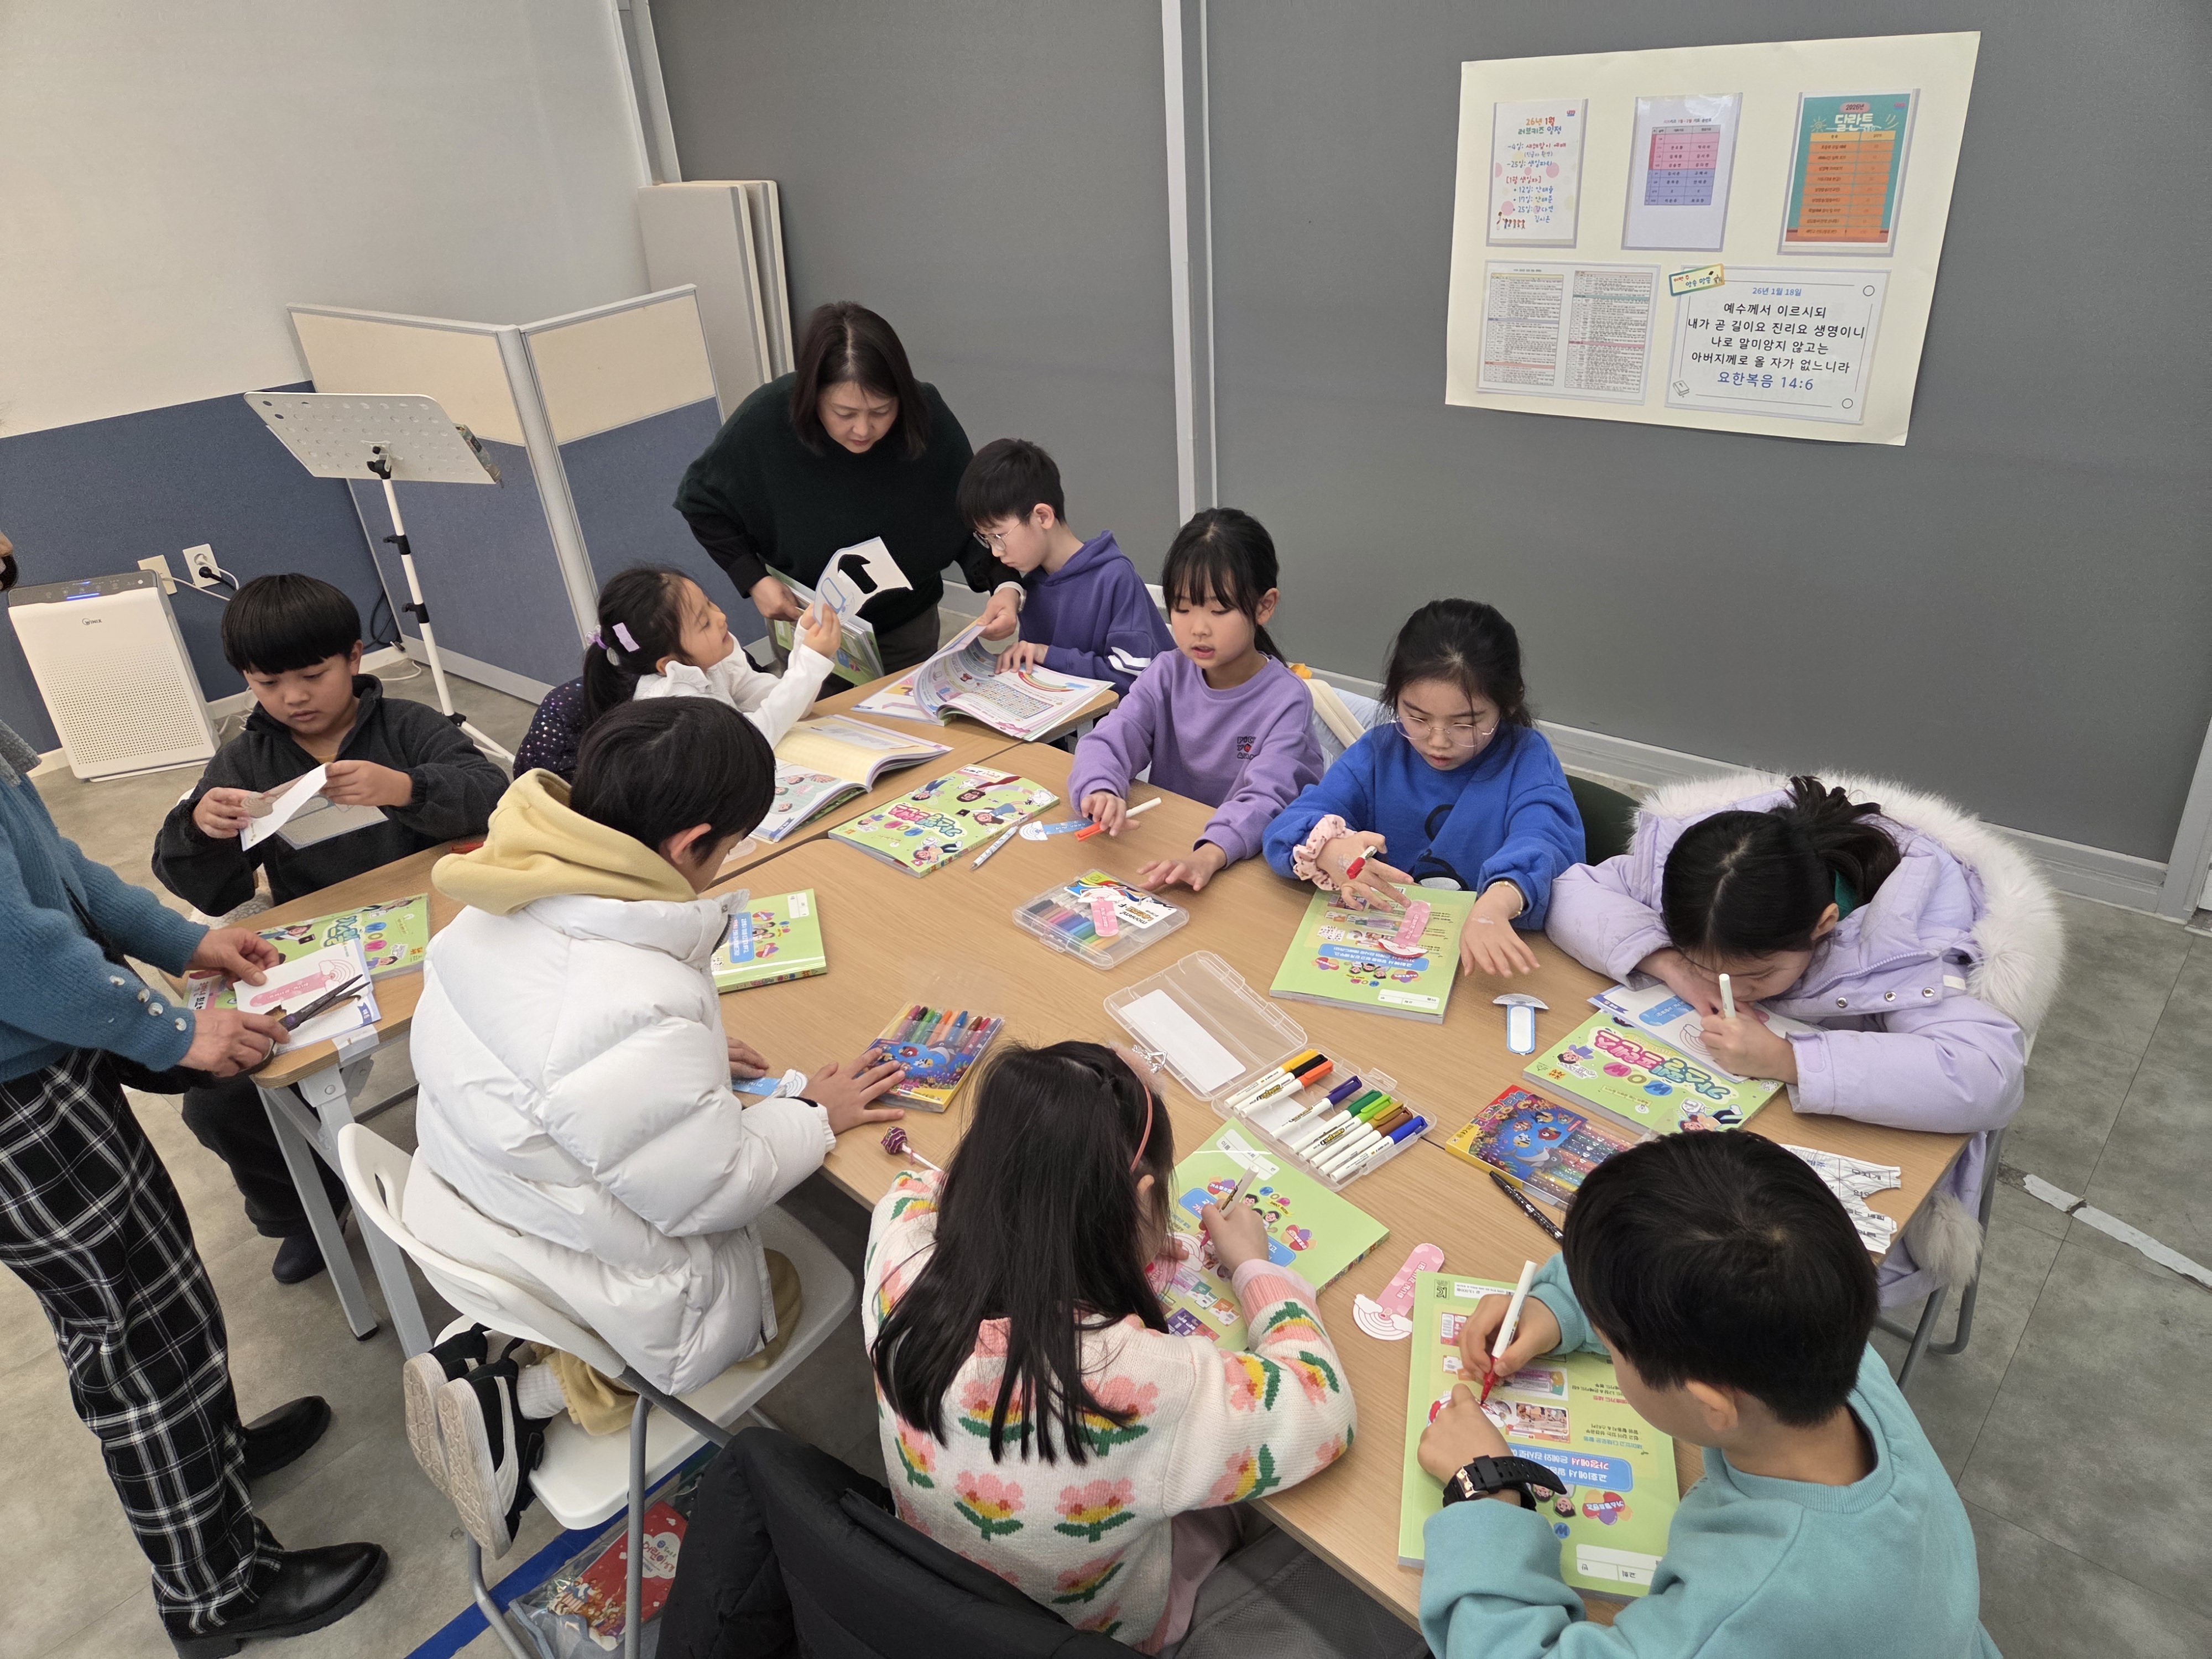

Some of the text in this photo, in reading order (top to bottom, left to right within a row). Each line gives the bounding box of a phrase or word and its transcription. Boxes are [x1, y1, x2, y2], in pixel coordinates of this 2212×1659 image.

[1526, 117, 1555, 126] 26년 1월
[1547, 126, 1562, 134] 일정
[1835, 113, 1874, 132] 달란트
[1752, 287, 1802, 296] 26년 1월 18일
[1724, 302, 1827, 319] 예수께서 이르시되
[1688, 318, 1865, 339] 내가 곧 길이요 진리요 생명이니
[1712, 336, 1829, 355] 나로 말미암지 않고는
[1692, 352, 1850, 374] 아버지께로 올 자가 없느니라
[1717, 372, 1814, 390] 요한복음 14:6
[1350, 978, 1380, 987] WOW
[1594, 1030, 1731, 1100] 가스펠프렌즈
[1603, 1062, 1673, 1097] WOW
[1324, 1128, 1345, 1144] namepen
[1221, 1140, 1231, 1151] 이름
[1259, 1186, 1291, 1207] WOW
[1519, 1450, 1609, 1470] 가정에서 은혜와 감사로
[1548, 1465, 1608, 1483] 교회에서 말씀
[1585, 1500, 1624, 1510] 가스펠프렌즈
[643, 1541, 669, 1565] 어린이
[1622, 1571, 1636, 1579] 교회
